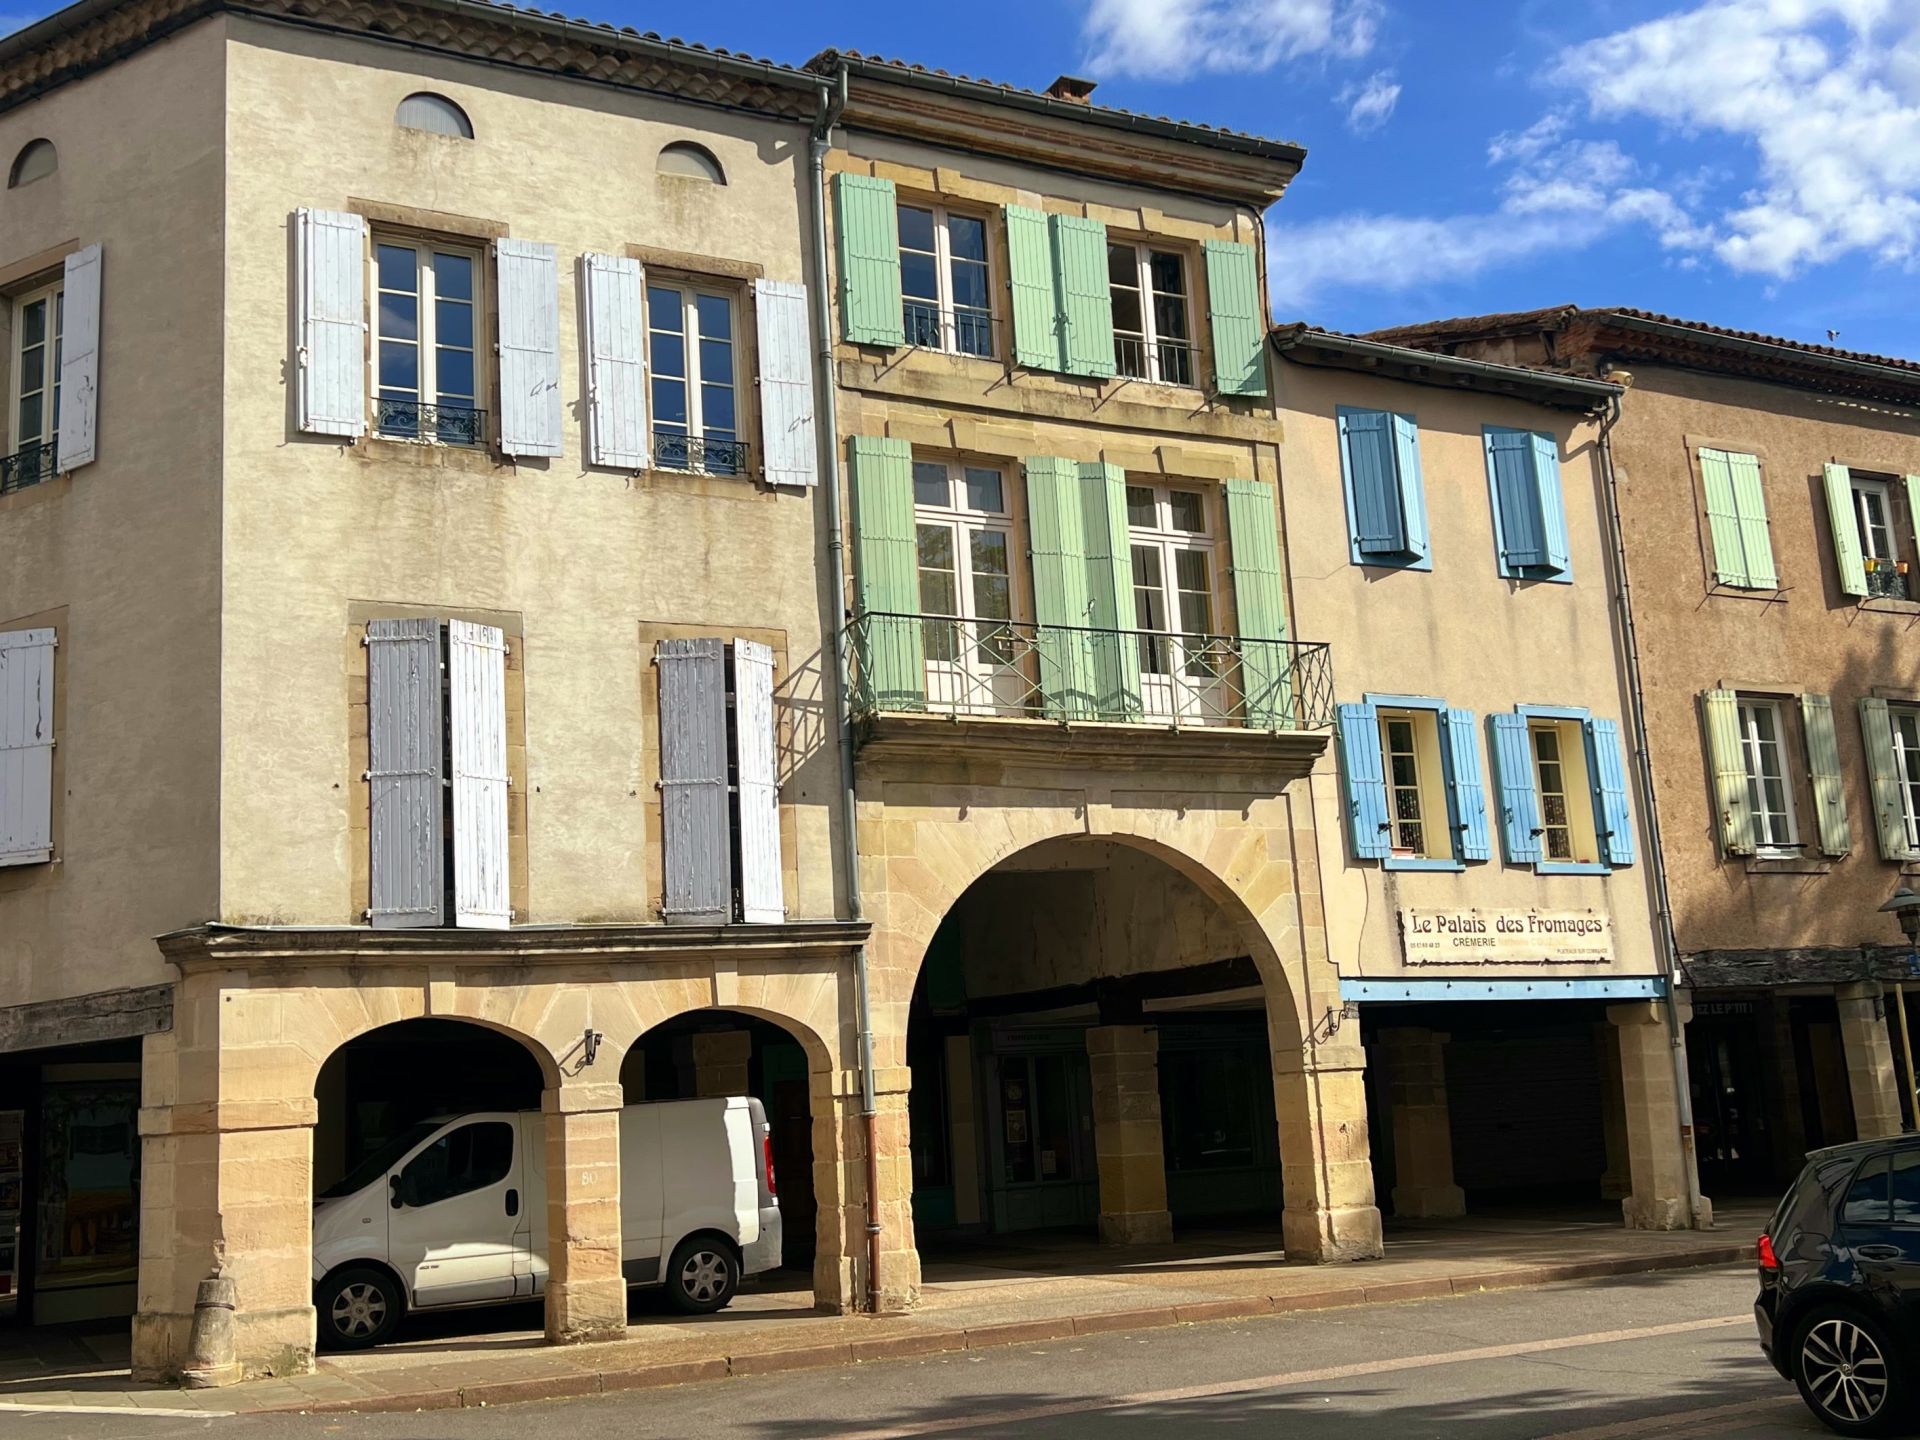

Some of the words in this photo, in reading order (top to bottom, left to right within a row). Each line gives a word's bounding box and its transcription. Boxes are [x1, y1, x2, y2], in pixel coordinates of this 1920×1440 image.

[1411, 916, 1432, 933] Le
[1436, 915, 1487, 933] Palais
[1496, 915, 1524, 933] des
[1527, 915, 1602, 937] Fromages
